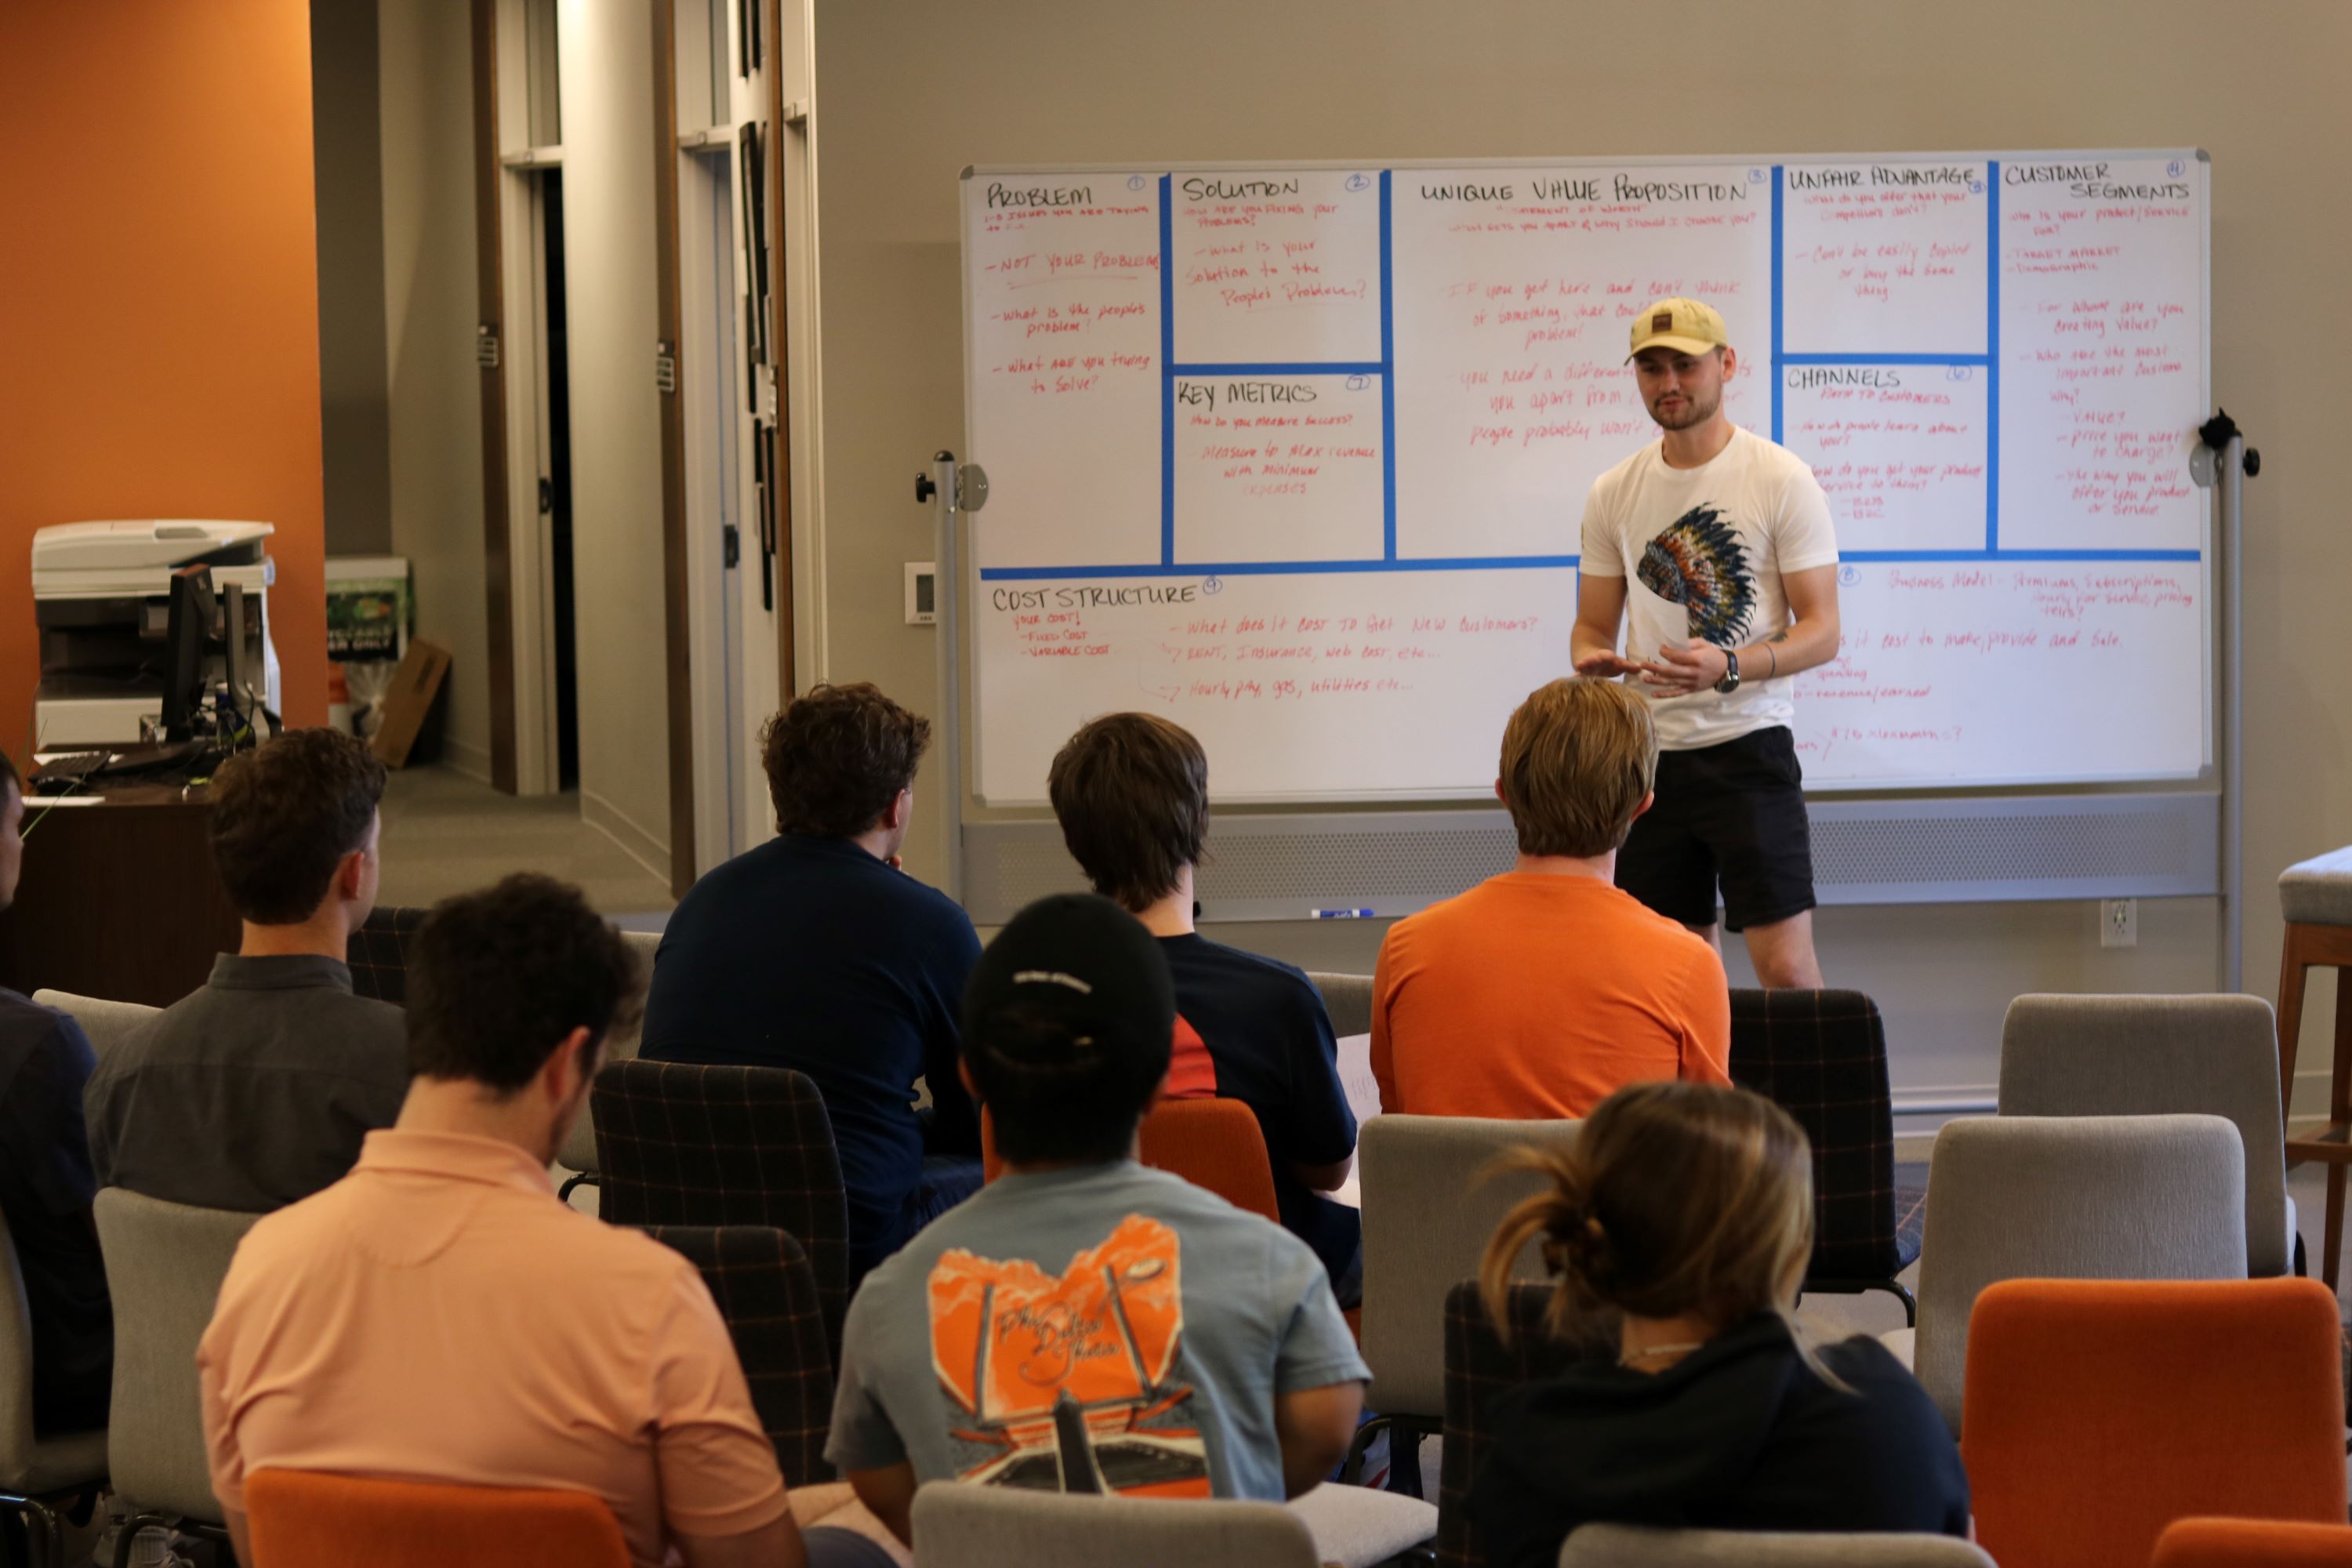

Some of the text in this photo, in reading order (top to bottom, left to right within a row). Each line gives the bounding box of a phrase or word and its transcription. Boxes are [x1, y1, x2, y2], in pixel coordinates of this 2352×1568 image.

[1791, 170, 1864, 190] UNFAIR
[1871, 166, 1973, 185] ADVANTAGE
[2005, 163, 2111, 185] CUSTOMER
[988, 183, 1091, 208] PROBLEM
[1183, 178, 1299, 201] SOLUTION
[1422, 184, 1513, 201] UNIQUE
[1533, 178, 1601, 202] VALUE
[1614, 173, 1747, 202] PROPOSITION
[2071, 183, 2190, 201] SEGMENTS
[1001, 255, 1036, 271] NOT
[1047, 253, 1085, 274] YOUR
[1293, 263, 1319, 274] the
[1069, 303, 1089, 316] the
[1789, 368, 1900, 388] CHANNELS
[1179, 382, 1214, 412] KEY
[1229, 383, 1317, 403] METRICS
[993, 588, 1051, 611] COST
[1058, 586, 1197, 608] STRUCTURE
